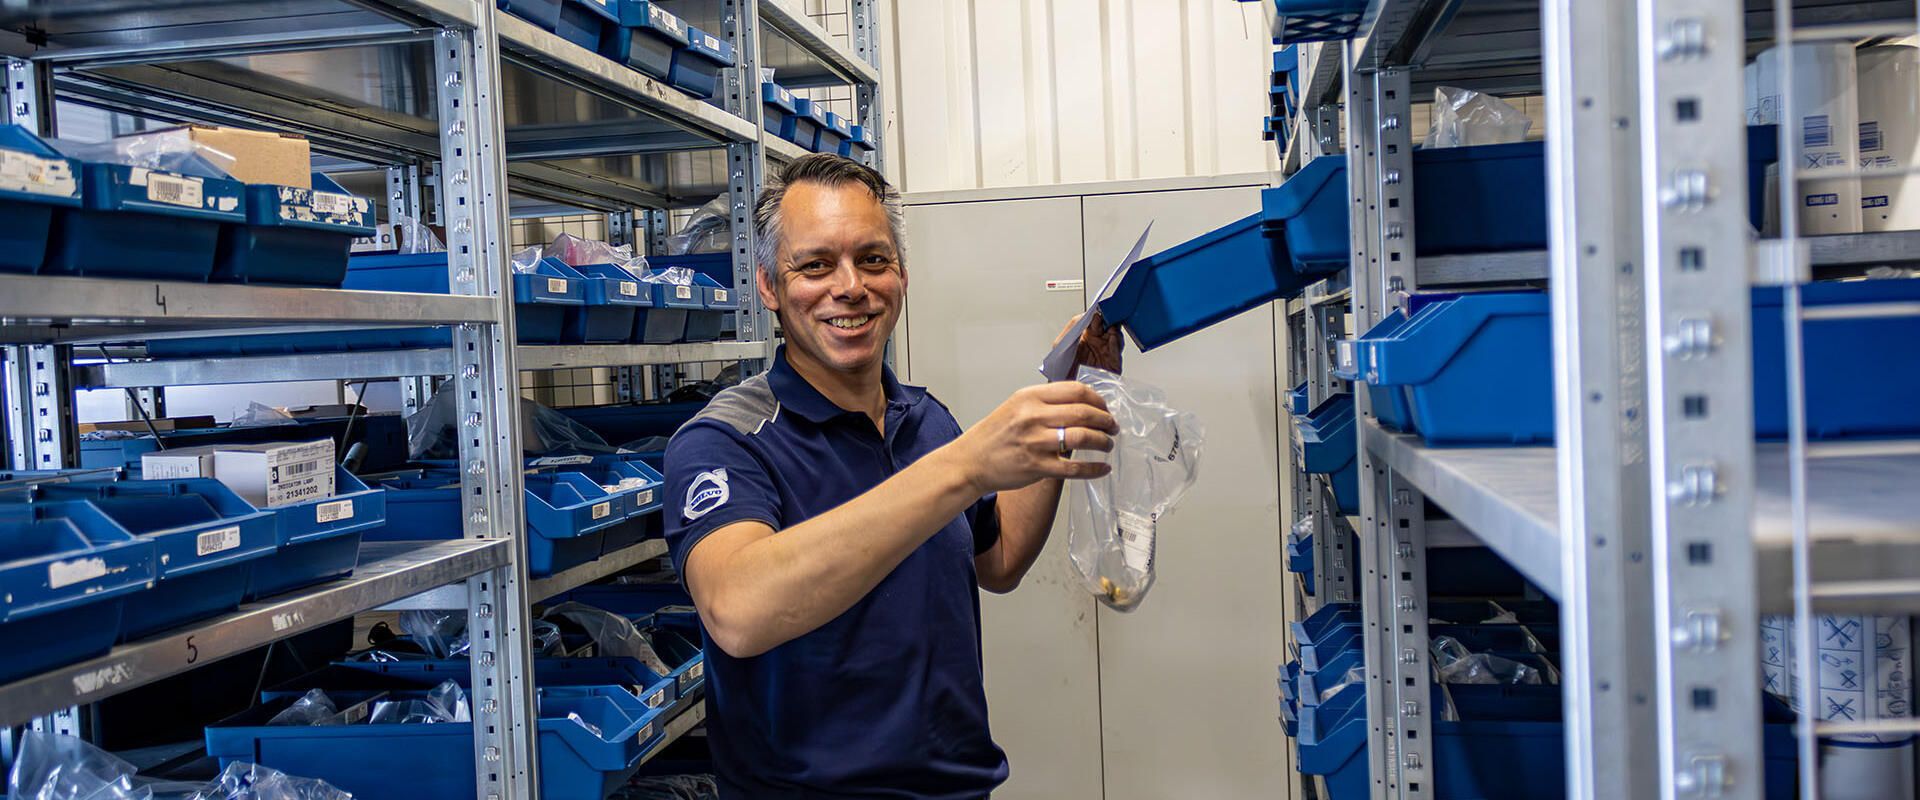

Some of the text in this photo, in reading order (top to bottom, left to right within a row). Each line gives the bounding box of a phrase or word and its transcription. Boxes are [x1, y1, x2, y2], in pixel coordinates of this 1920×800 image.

[156, 284, 167, 315] 4
[286, 485, 318, 499] 21341202
[187, 635, 198, 664] 5
